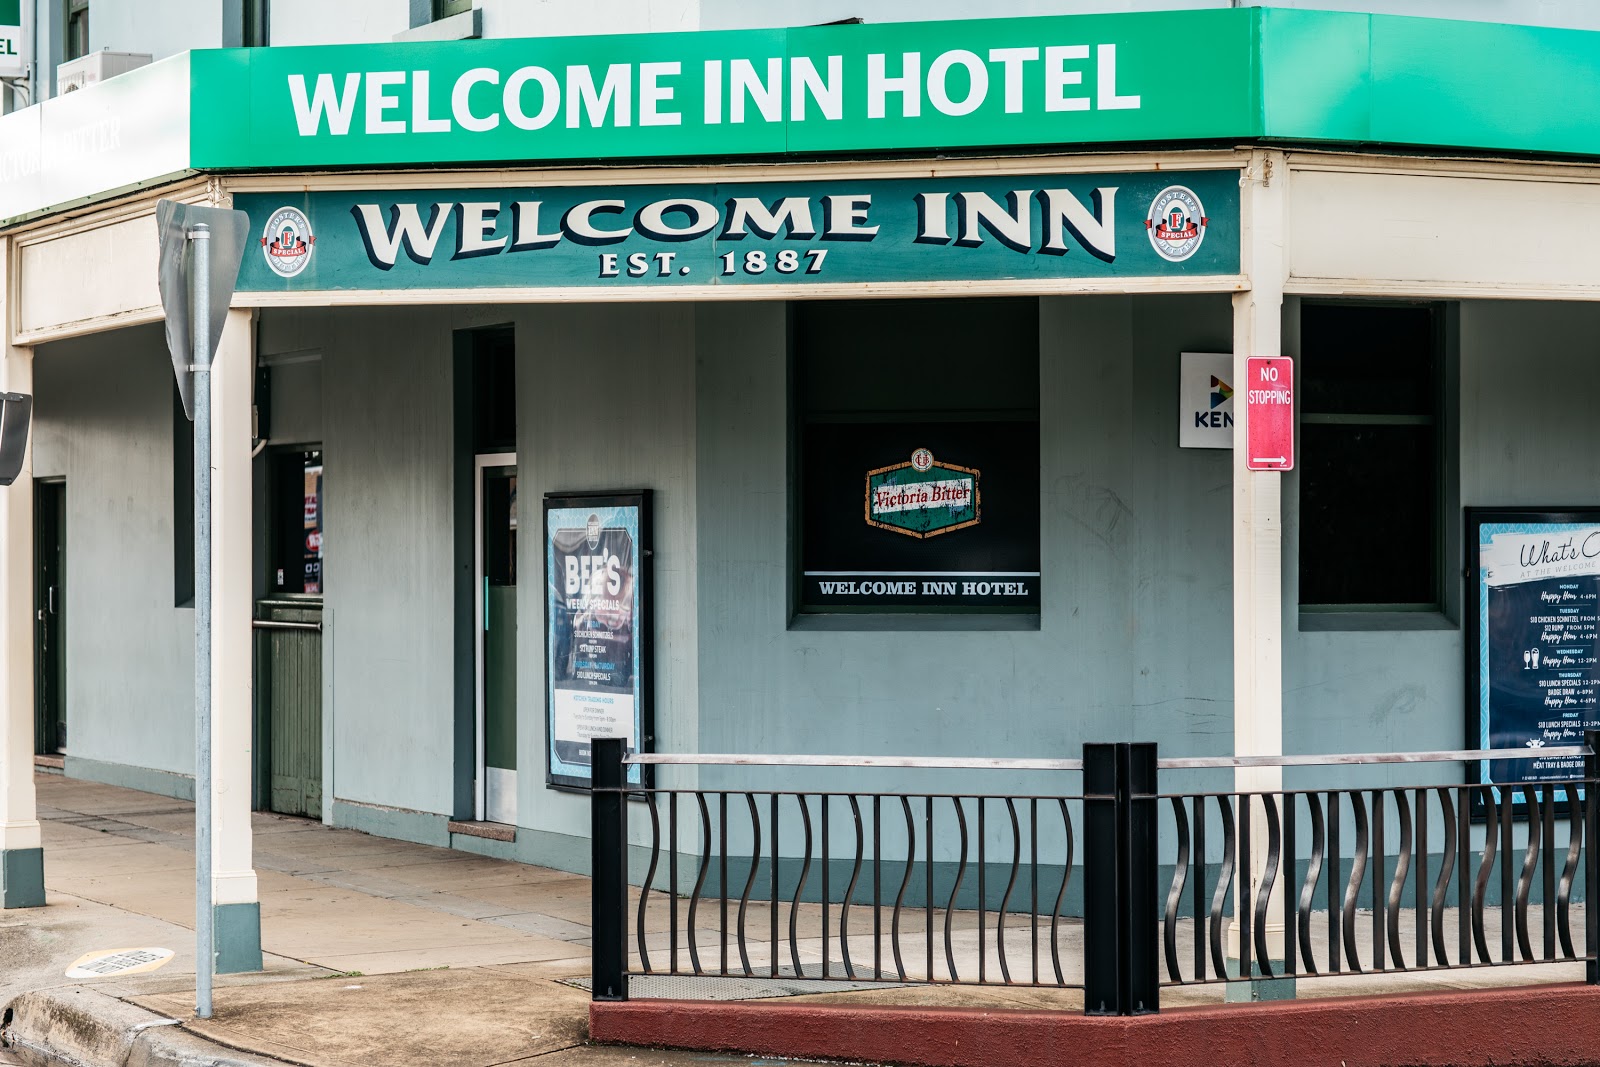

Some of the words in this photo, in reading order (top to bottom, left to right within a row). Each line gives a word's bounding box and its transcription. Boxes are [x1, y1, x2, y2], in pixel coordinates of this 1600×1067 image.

[288, 61, 682, 136] WELCOME
[703, 55, 843, 124] INN
[867, 43, 1141, 119] HOTEL
[1157, 192, 1197, 212] FOSTER'S
[271, 212, 305, 230] FOSTER'S
[351, 193, 881, 270] WELCOME
[914, 187, 1119, 263] INN
[1170, 212, 1183, 229] F
[283, 231, 293, 247] F
[1159, 238, 1195, 254] BITTER
[599, 252, 691, 278] EST.
[720, 249, 829, 276] 1887
[1260, 367, 1279, 382] NO
[1248, 389, 1291, 405] STOPPING
[1195, 411, 1234, 428] KEN
[877, 488, 928, 507] Victoria
[931, 485, 970, 502] Bitter
[1520, 537, 1580, 567] What's
[565, 547, 621, 596] BEE'S
[1536, 568, 1551, 576] THE
[1555, 562, 1596, 573] WELCOME
[818, 581, 917, 595] WELCOME
[921, 581, 957, 595] INN
[962, 582, 1029, 596] HOTEL
[589, 599, 620, 610] SPECIALS
[1541, 591, 1561, 604] Happy
[1563, 590, 1577, 600] Hour
[1541, 631, 1561, 644] Happy
[1563, 630, 1577, 641] Hour
[1542, 655, 1562, 668] Happy
[1562, 655, 1576, 664] Hour
[1544, 696, 1563, 708] Happy
[1564, 696, 1577, 705] Hour
[1543, 728, 1562, 740] Happy
[1563, 728, 1576, 737] Hour
[1561, 760, 1575, 768] BADGE
